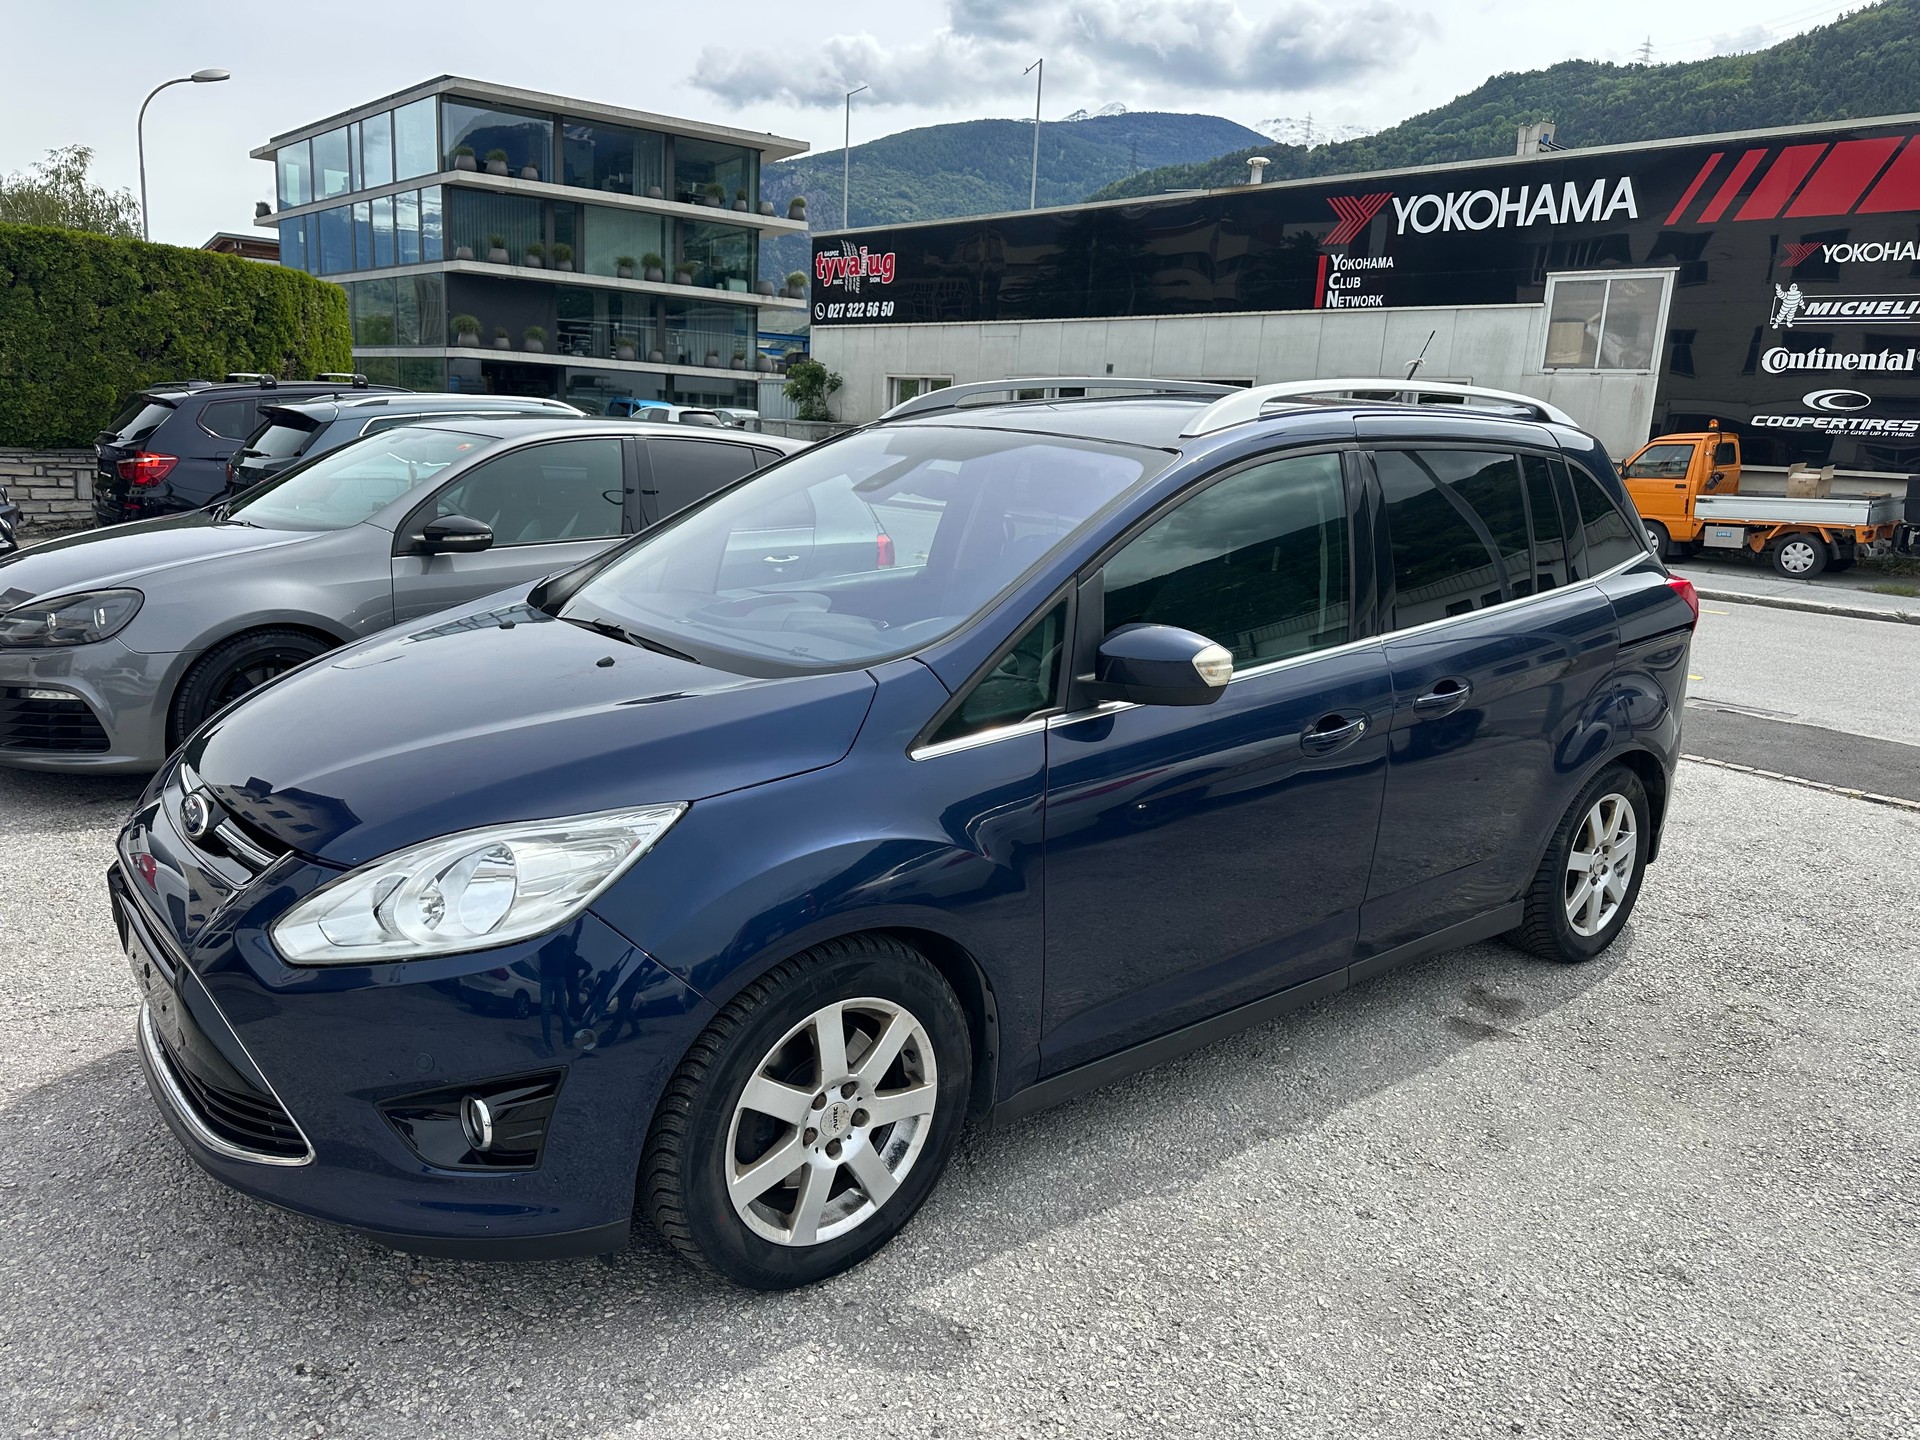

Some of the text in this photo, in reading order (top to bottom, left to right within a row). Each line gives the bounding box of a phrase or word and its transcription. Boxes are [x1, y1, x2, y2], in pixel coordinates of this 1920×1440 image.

[1392, 176, 1638, 235] YOKOHAMA
[1822, 241, 1920, 263] YOKOHA
[1330, 253, 1394, 271] YOKOHAMA
[1329, 272, 1361, 289] CLUB
[1325, 290, 1384, 308] NETWORK
[1804, 300, 1920, 316] MICHELI
[827, 301, 894, 318] 027 322 56 50
[1761, 346, 1916, 374] Continental
